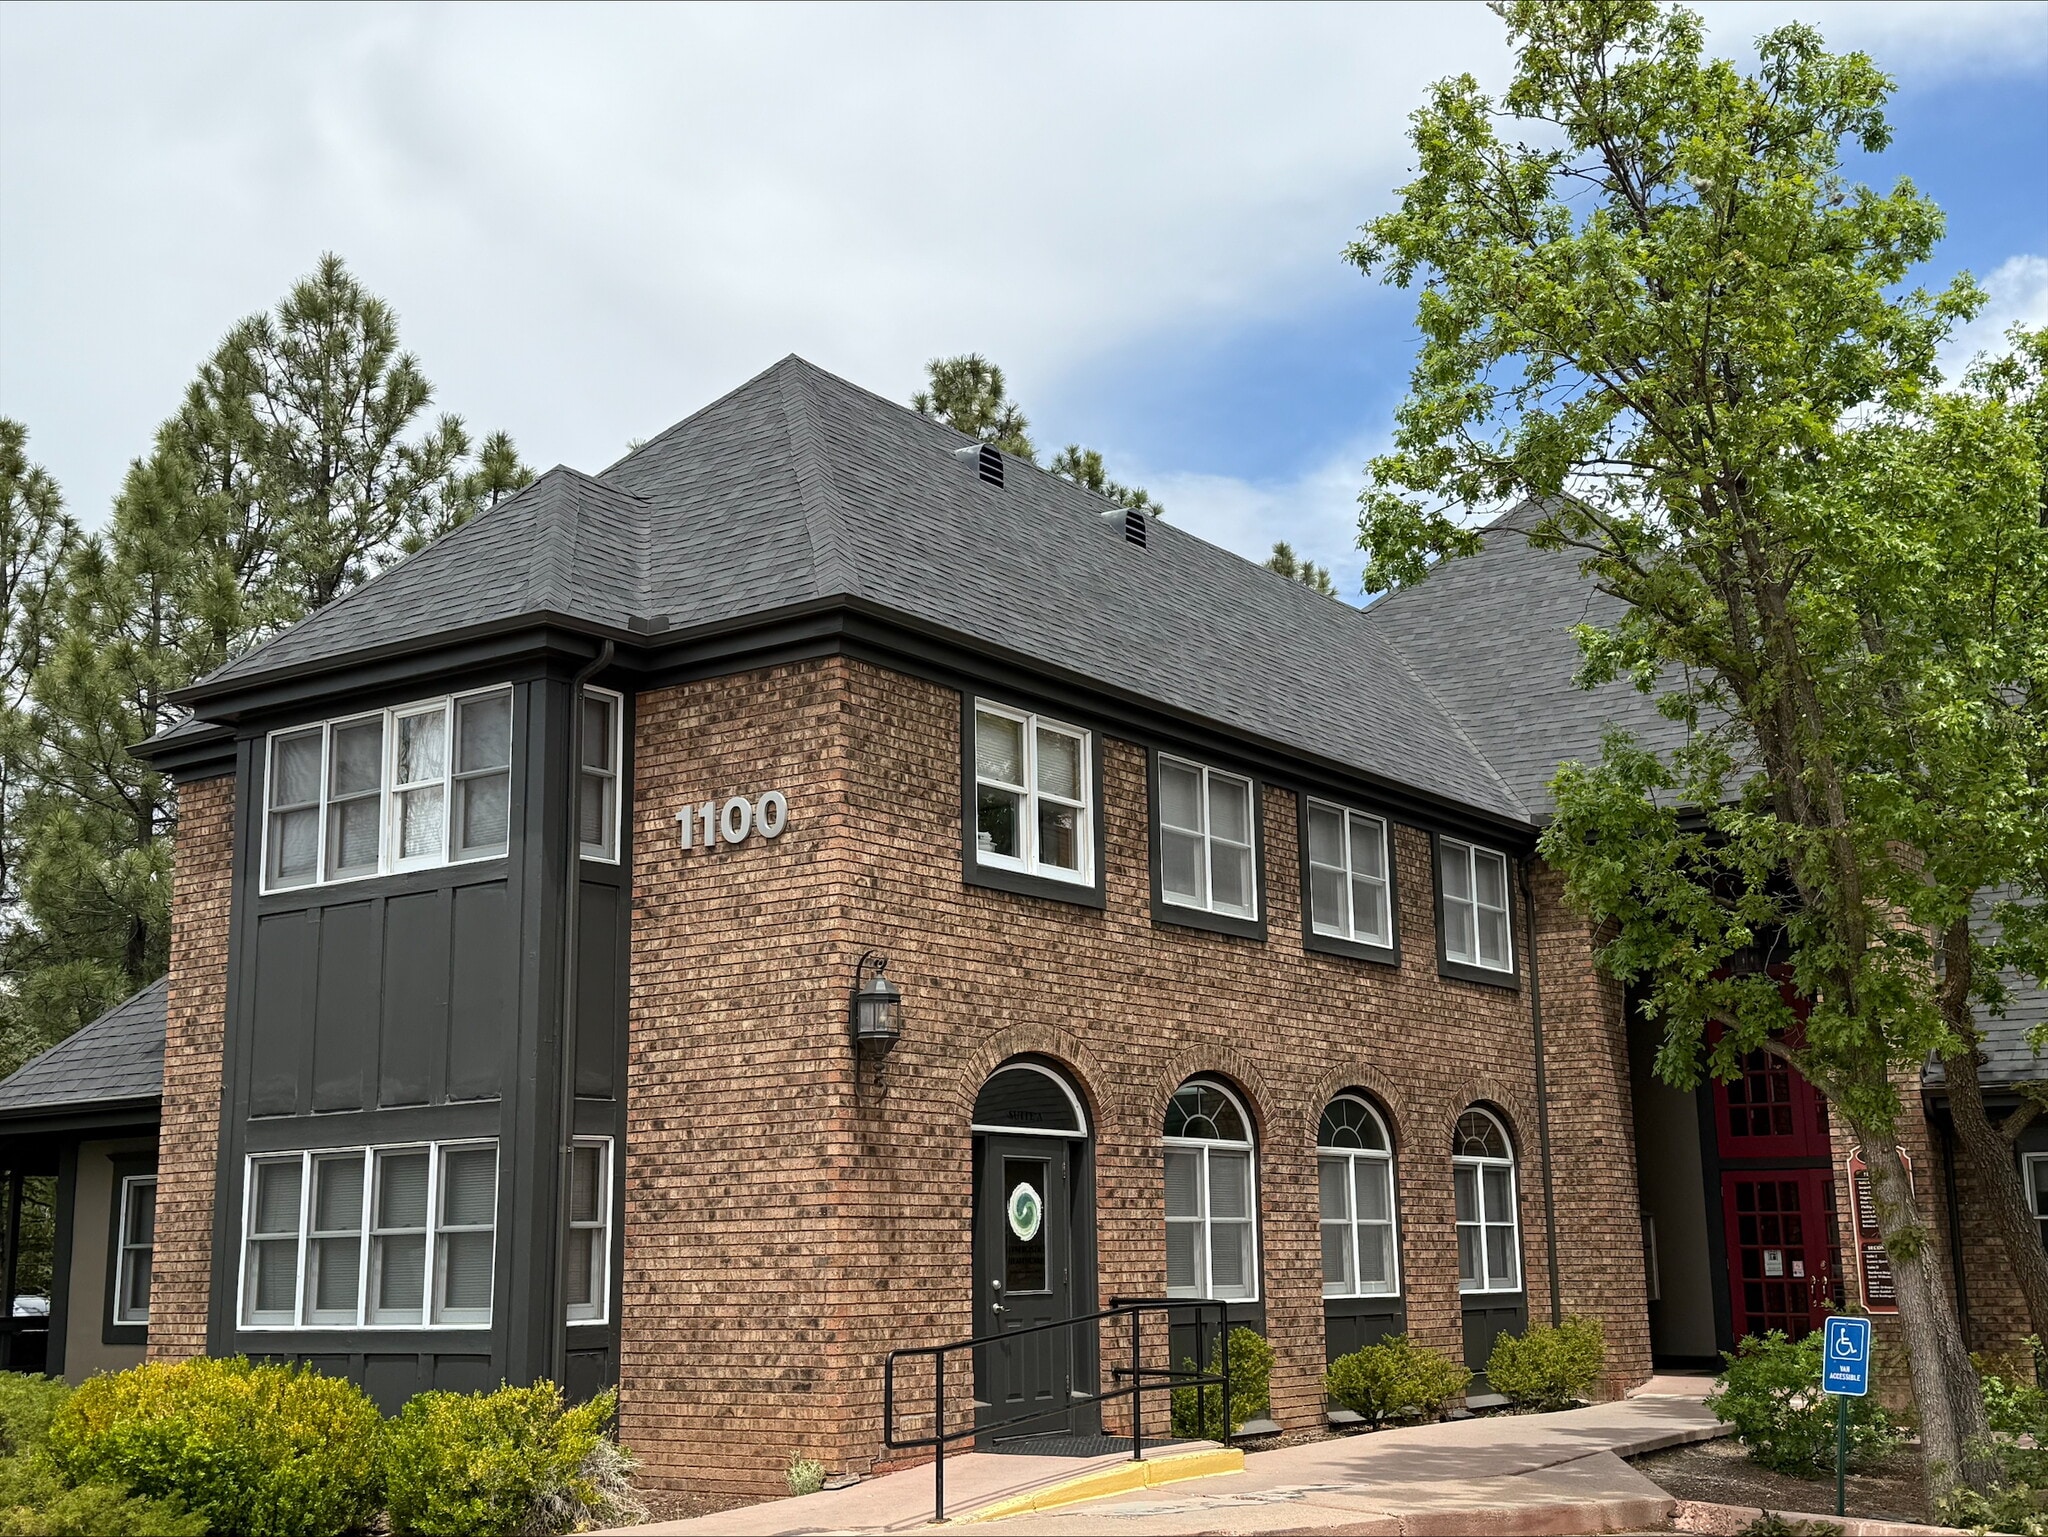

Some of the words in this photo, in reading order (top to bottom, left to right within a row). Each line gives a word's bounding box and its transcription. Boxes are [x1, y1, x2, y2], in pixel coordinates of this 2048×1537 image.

[674, 790, 788, 850] 1100
[1007, 1110, 1035, 1121] SUITE
[1839, 1365, 1850, 1373] VAN
[1829, 1372, 1861, 1382] ACCESSIBLE
